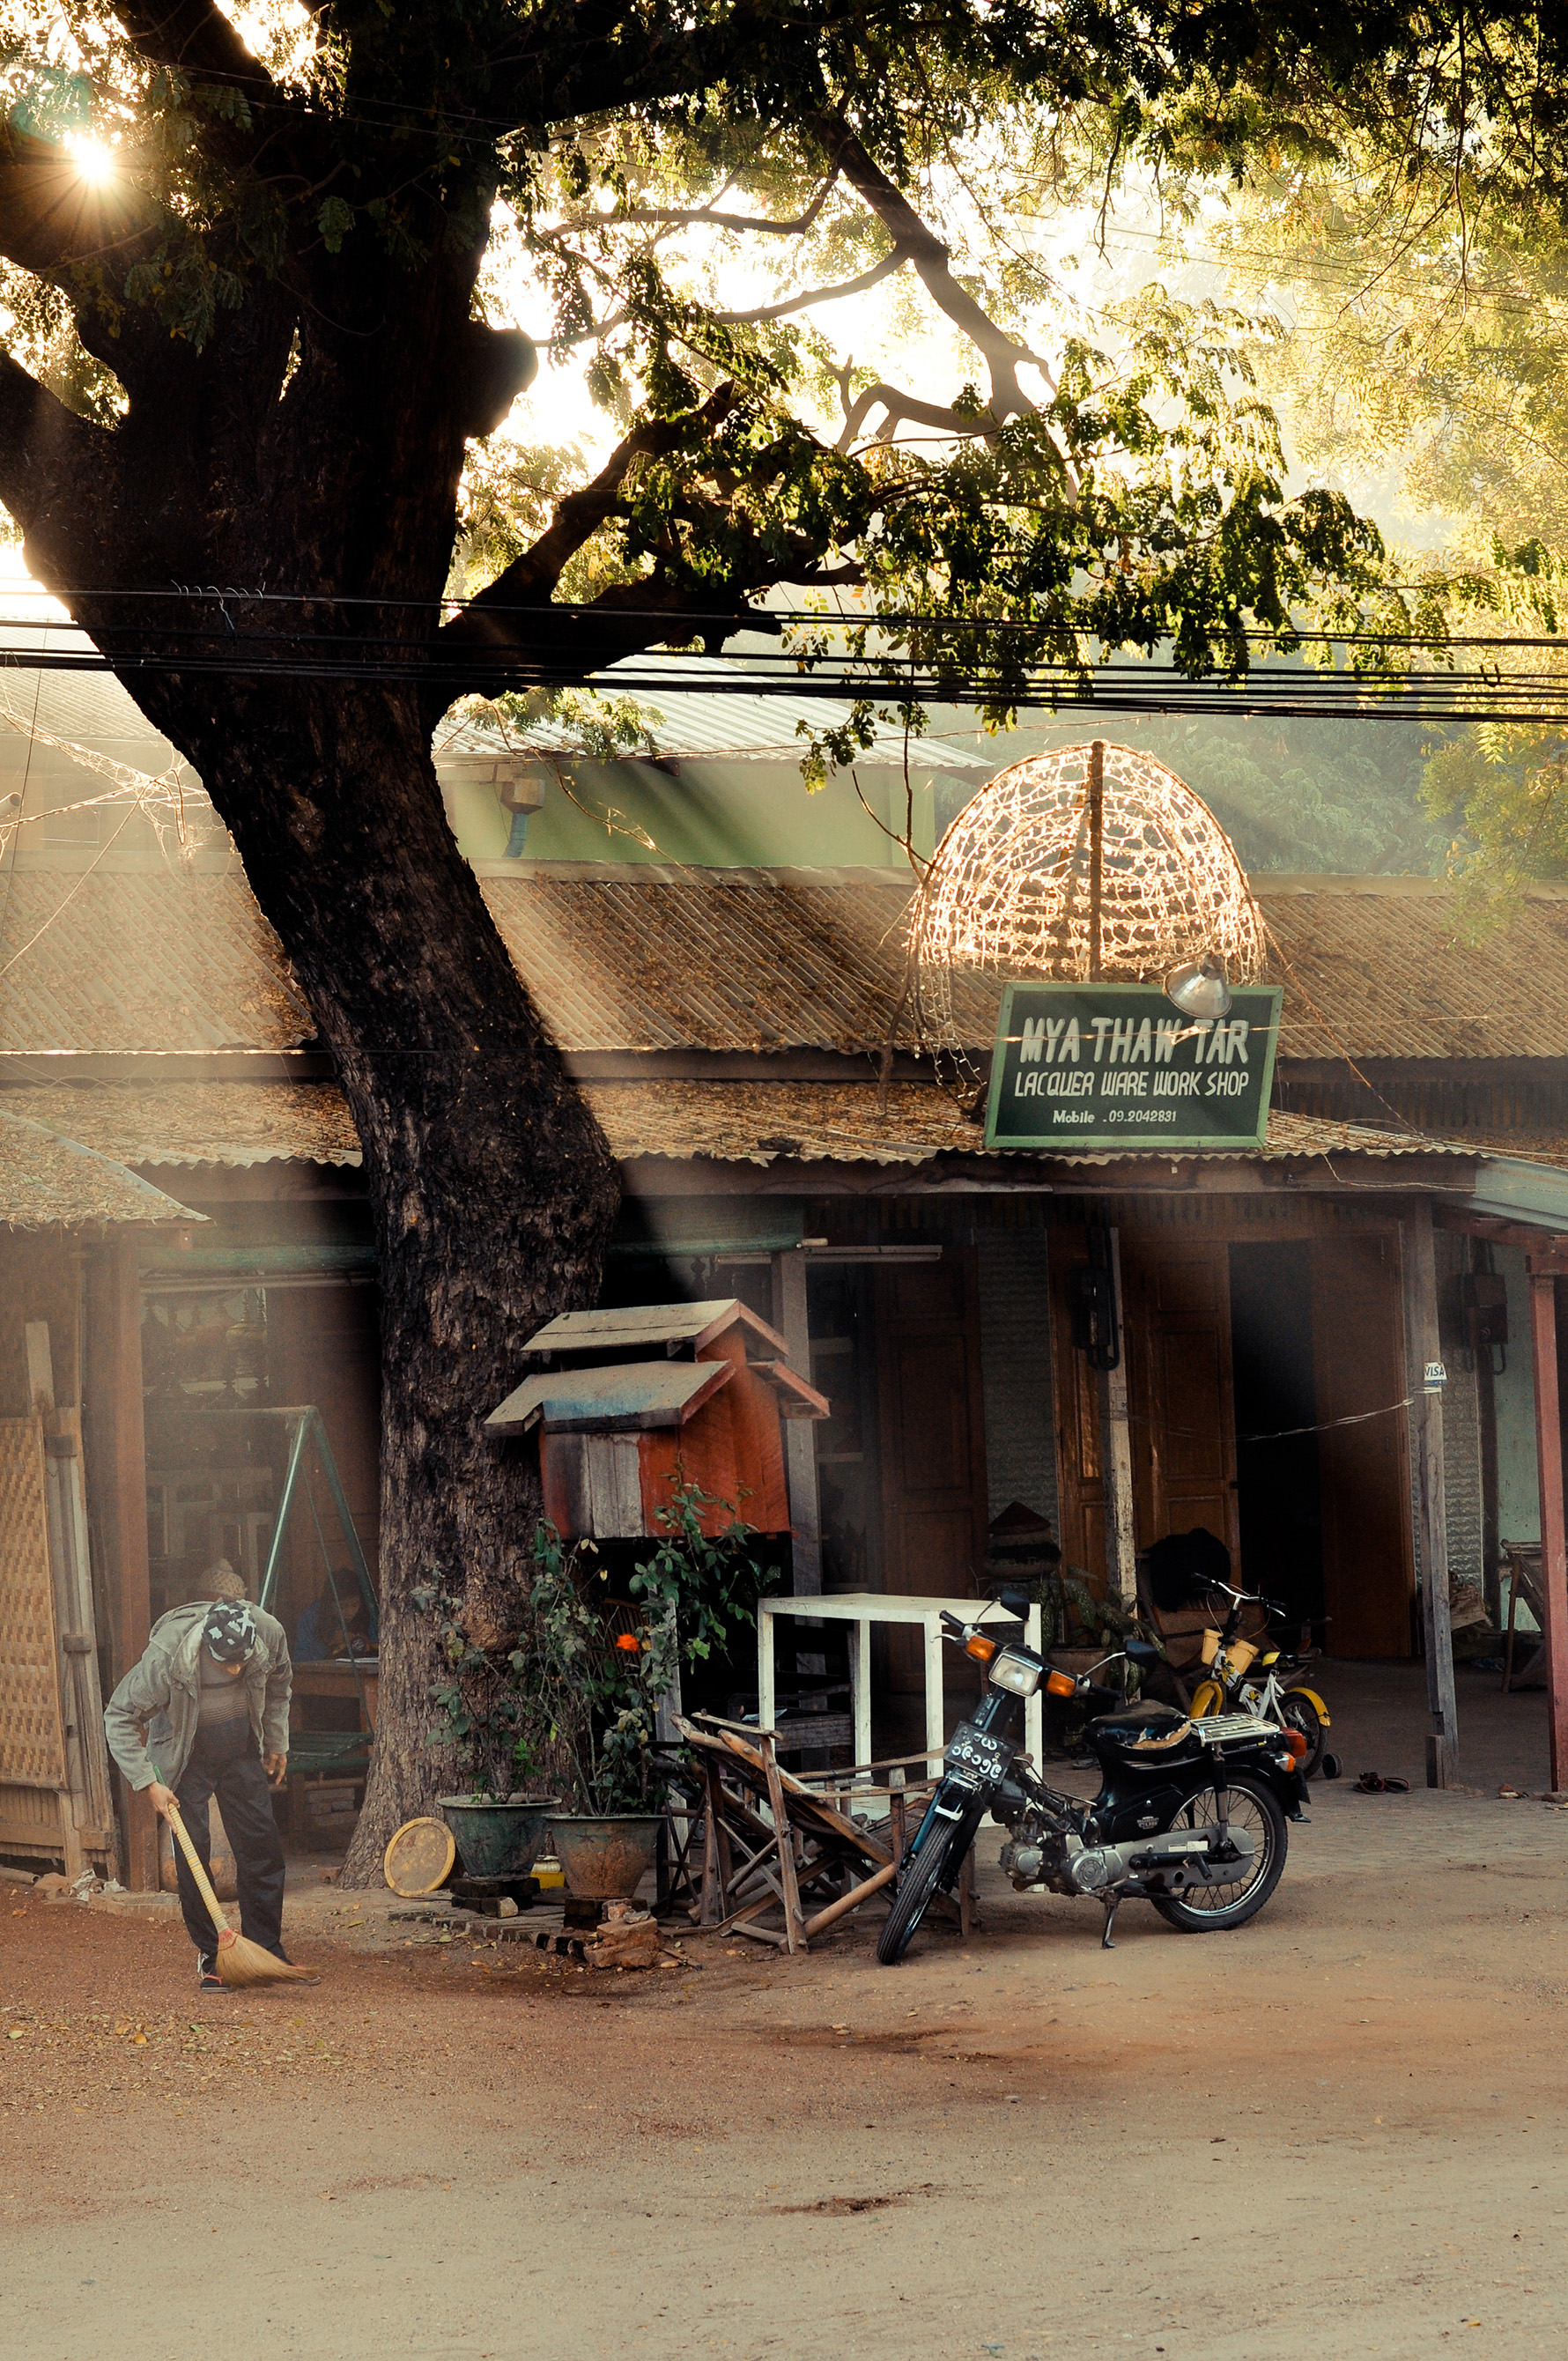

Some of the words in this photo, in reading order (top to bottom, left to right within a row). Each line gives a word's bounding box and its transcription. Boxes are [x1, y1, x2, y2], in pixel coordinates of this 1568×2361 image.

[1020, 1017, 1080, 1062] MYA
[1091, 1017, 1182, 1063] THAW
[1194, 1018, 1250, 1064] TAR
[1015, 1071, 1095, 1097] LACQUER
[1100, 1071, 1149, 1097] WARE
[1152, 1071, 1202, 1097] WORK
[1204, 1071, 1249, 1097] SHOP
[1052, 1109, 1095, 1123] Mobile
[1424, 1366, 1445, 1376] VISA
